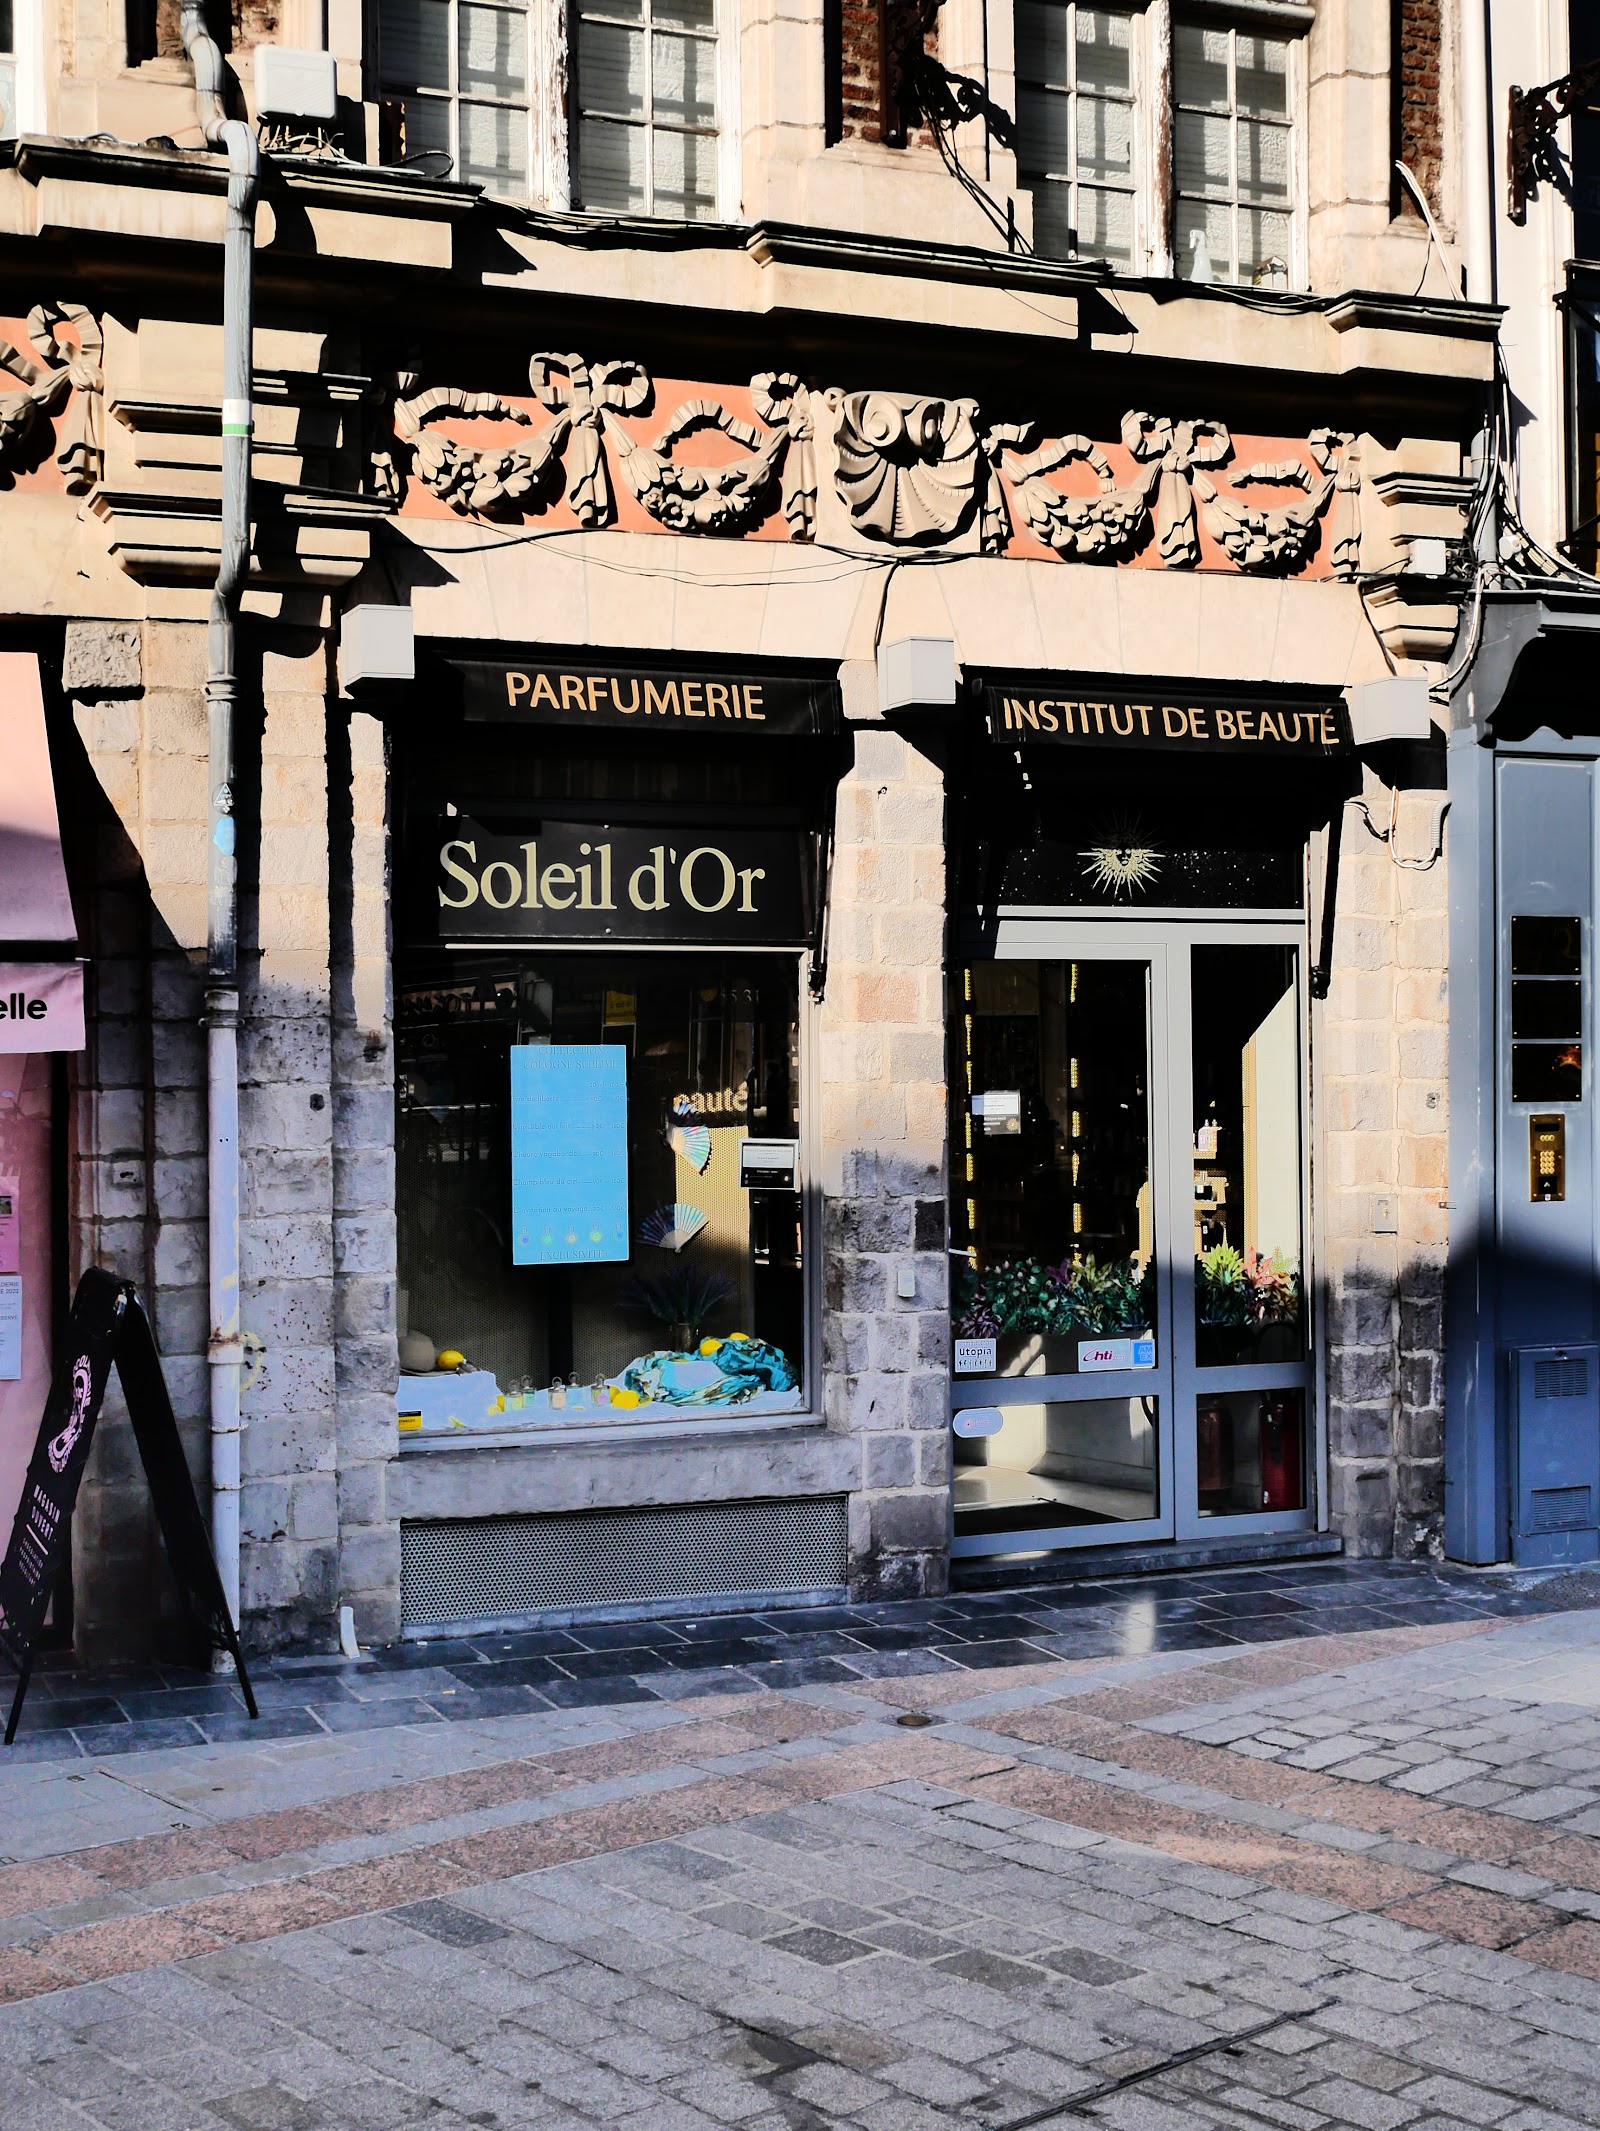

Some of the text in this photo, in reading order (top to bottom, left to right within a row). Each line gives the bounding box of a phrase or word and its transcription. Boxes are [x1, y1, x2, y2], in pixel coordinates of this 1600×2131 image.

[505, 671, 766, 720] PARFUMERIE
[1002, 697, 1341, 745] INSTITUT DE BEAUTÉ
[438, 839, 766, 913] Soleil d'Or
[523, 1059, 619, 1070] COLOGNE SUBLIME
[538, 1045, 605, 1055] COLLECTION
[959, 1347, 992, 1358] Utopia
[31, 1505, 54, 1541] OUVERT
[33, 1484, 61, 1524] MAGASIN
